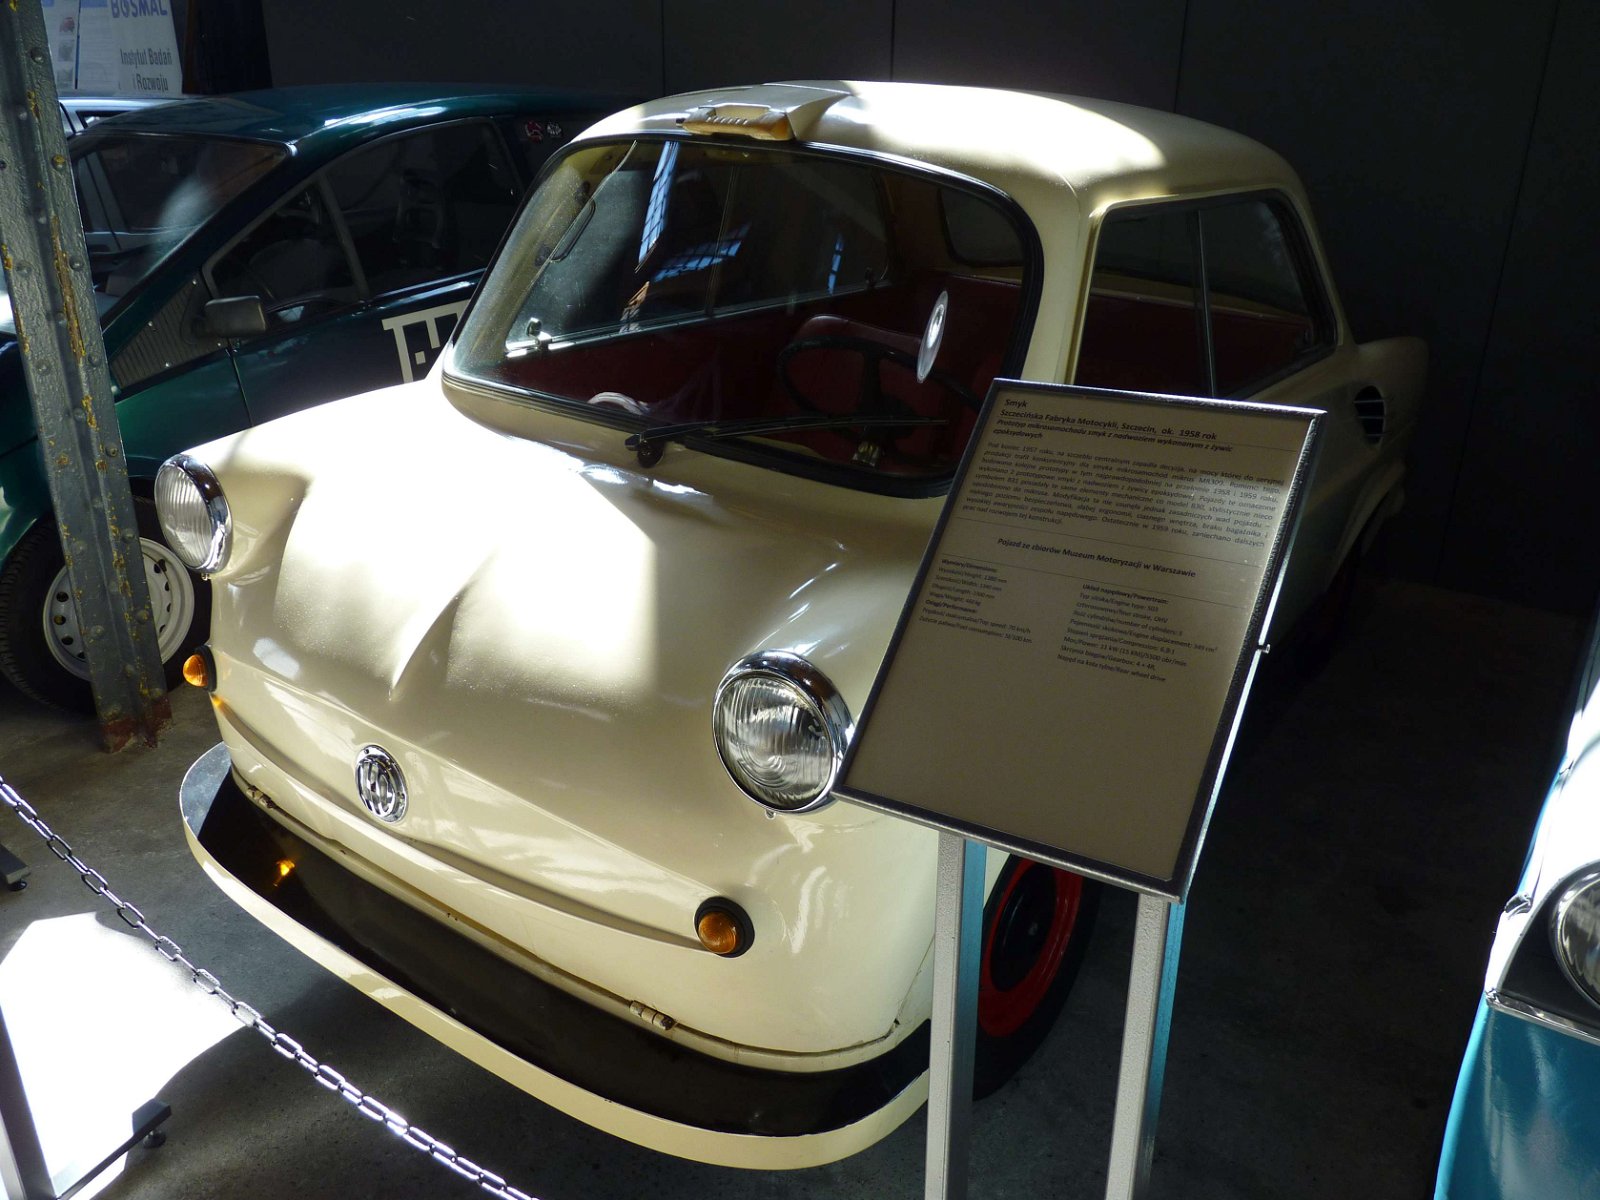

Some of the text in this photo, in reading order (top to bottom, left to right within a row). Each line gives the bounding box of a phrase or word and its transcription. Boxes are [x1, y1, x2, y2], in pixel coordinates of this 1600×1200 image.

[120, 47, 173, 68] Instytut Badań
[136, 73, 169, 93] Rozwoju
[1004, 399, 1028, 408] Smyk
[1000, 409, 1044, 419] Szczecińska
[1044, 414, 1076, 424] Fabryka
[1076, 418, 1120, 429] Motocykli,
[1121, 422, 1158, 433] Szczecin,
[1179, 429, 1201, 437] 1958
[1202, 431, 1217, 439] rok
[1157, 437, 1204, 448] wykonanym
[997, 537, 1021, 548] Pojazd
[1032, 543, 1060, 553] zbiorów
[1062, 548, 1096, 559] Muzeum
[1096, 554, 1142, 568] Motoryzacji
[1152, 563, 1197, 576] Warszawie
